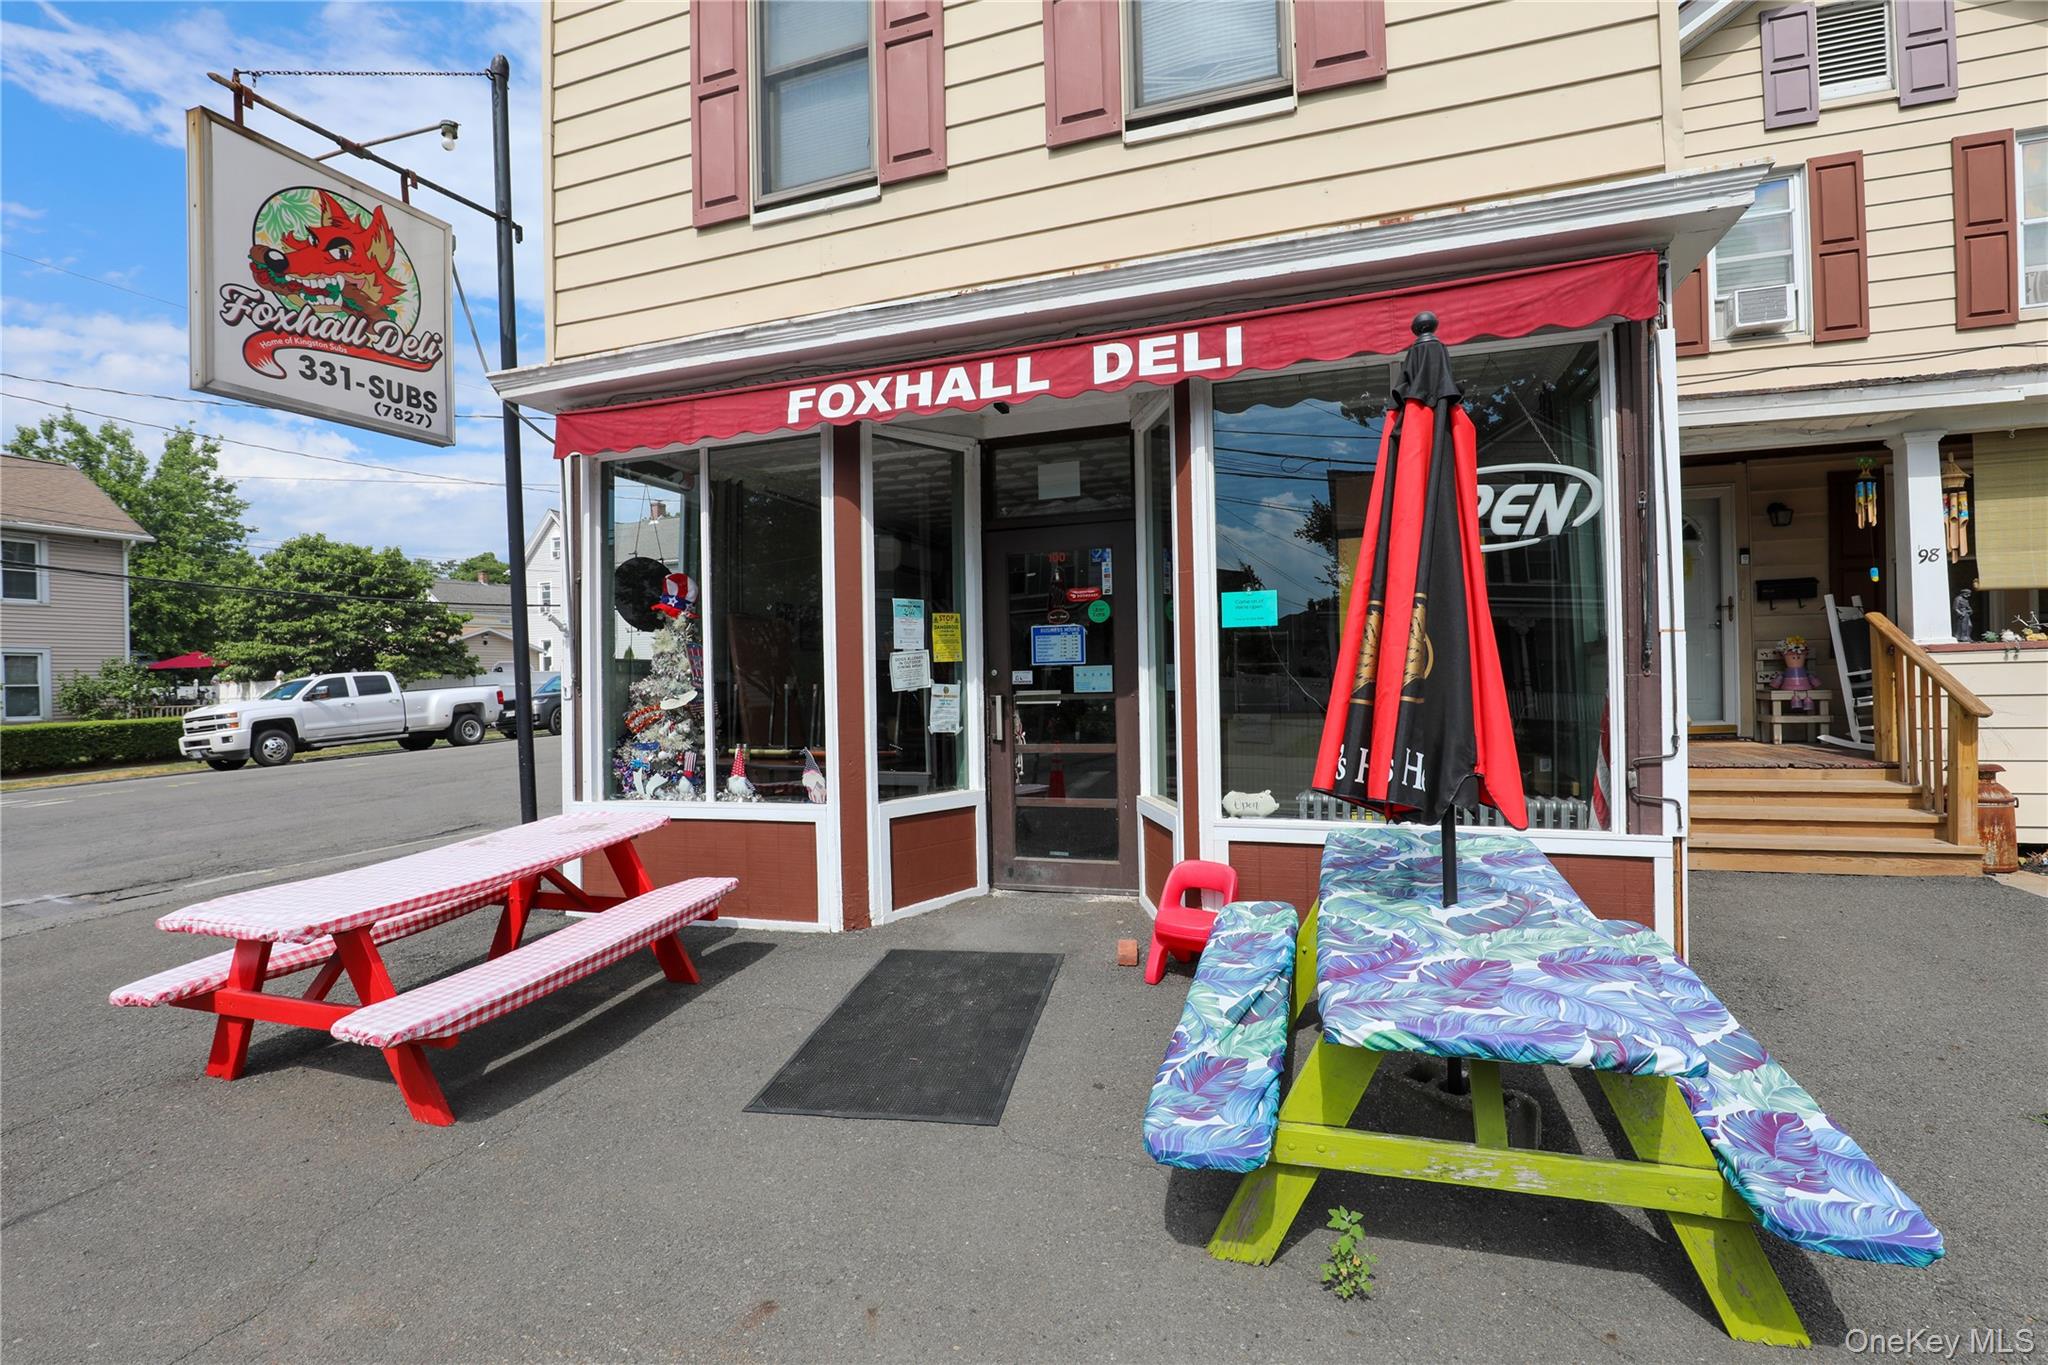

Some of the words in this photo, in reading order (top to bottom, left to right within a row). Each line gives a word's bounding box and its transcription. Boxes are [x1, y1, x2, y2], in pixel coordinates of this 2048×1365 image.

[219, 283, 368, 348] Foxhall
[372, 320, 443, 362] Deli
[259, 337, 283, 349] Home
[285, 336, 292, 344] of
[294, 337, 328, 349] Kingston
[328, 342, 348, 353] Subs
[299, 355, 438, 413] 331-SUBS
[786, 356, 1050, 425] FOXHALL
[1092, 325, 1243, 385] DELI
[374, 401, 432, 428] (7827)
[1918, 548, 1940, 565] 98
[938, 614, 954, 622] STOP
